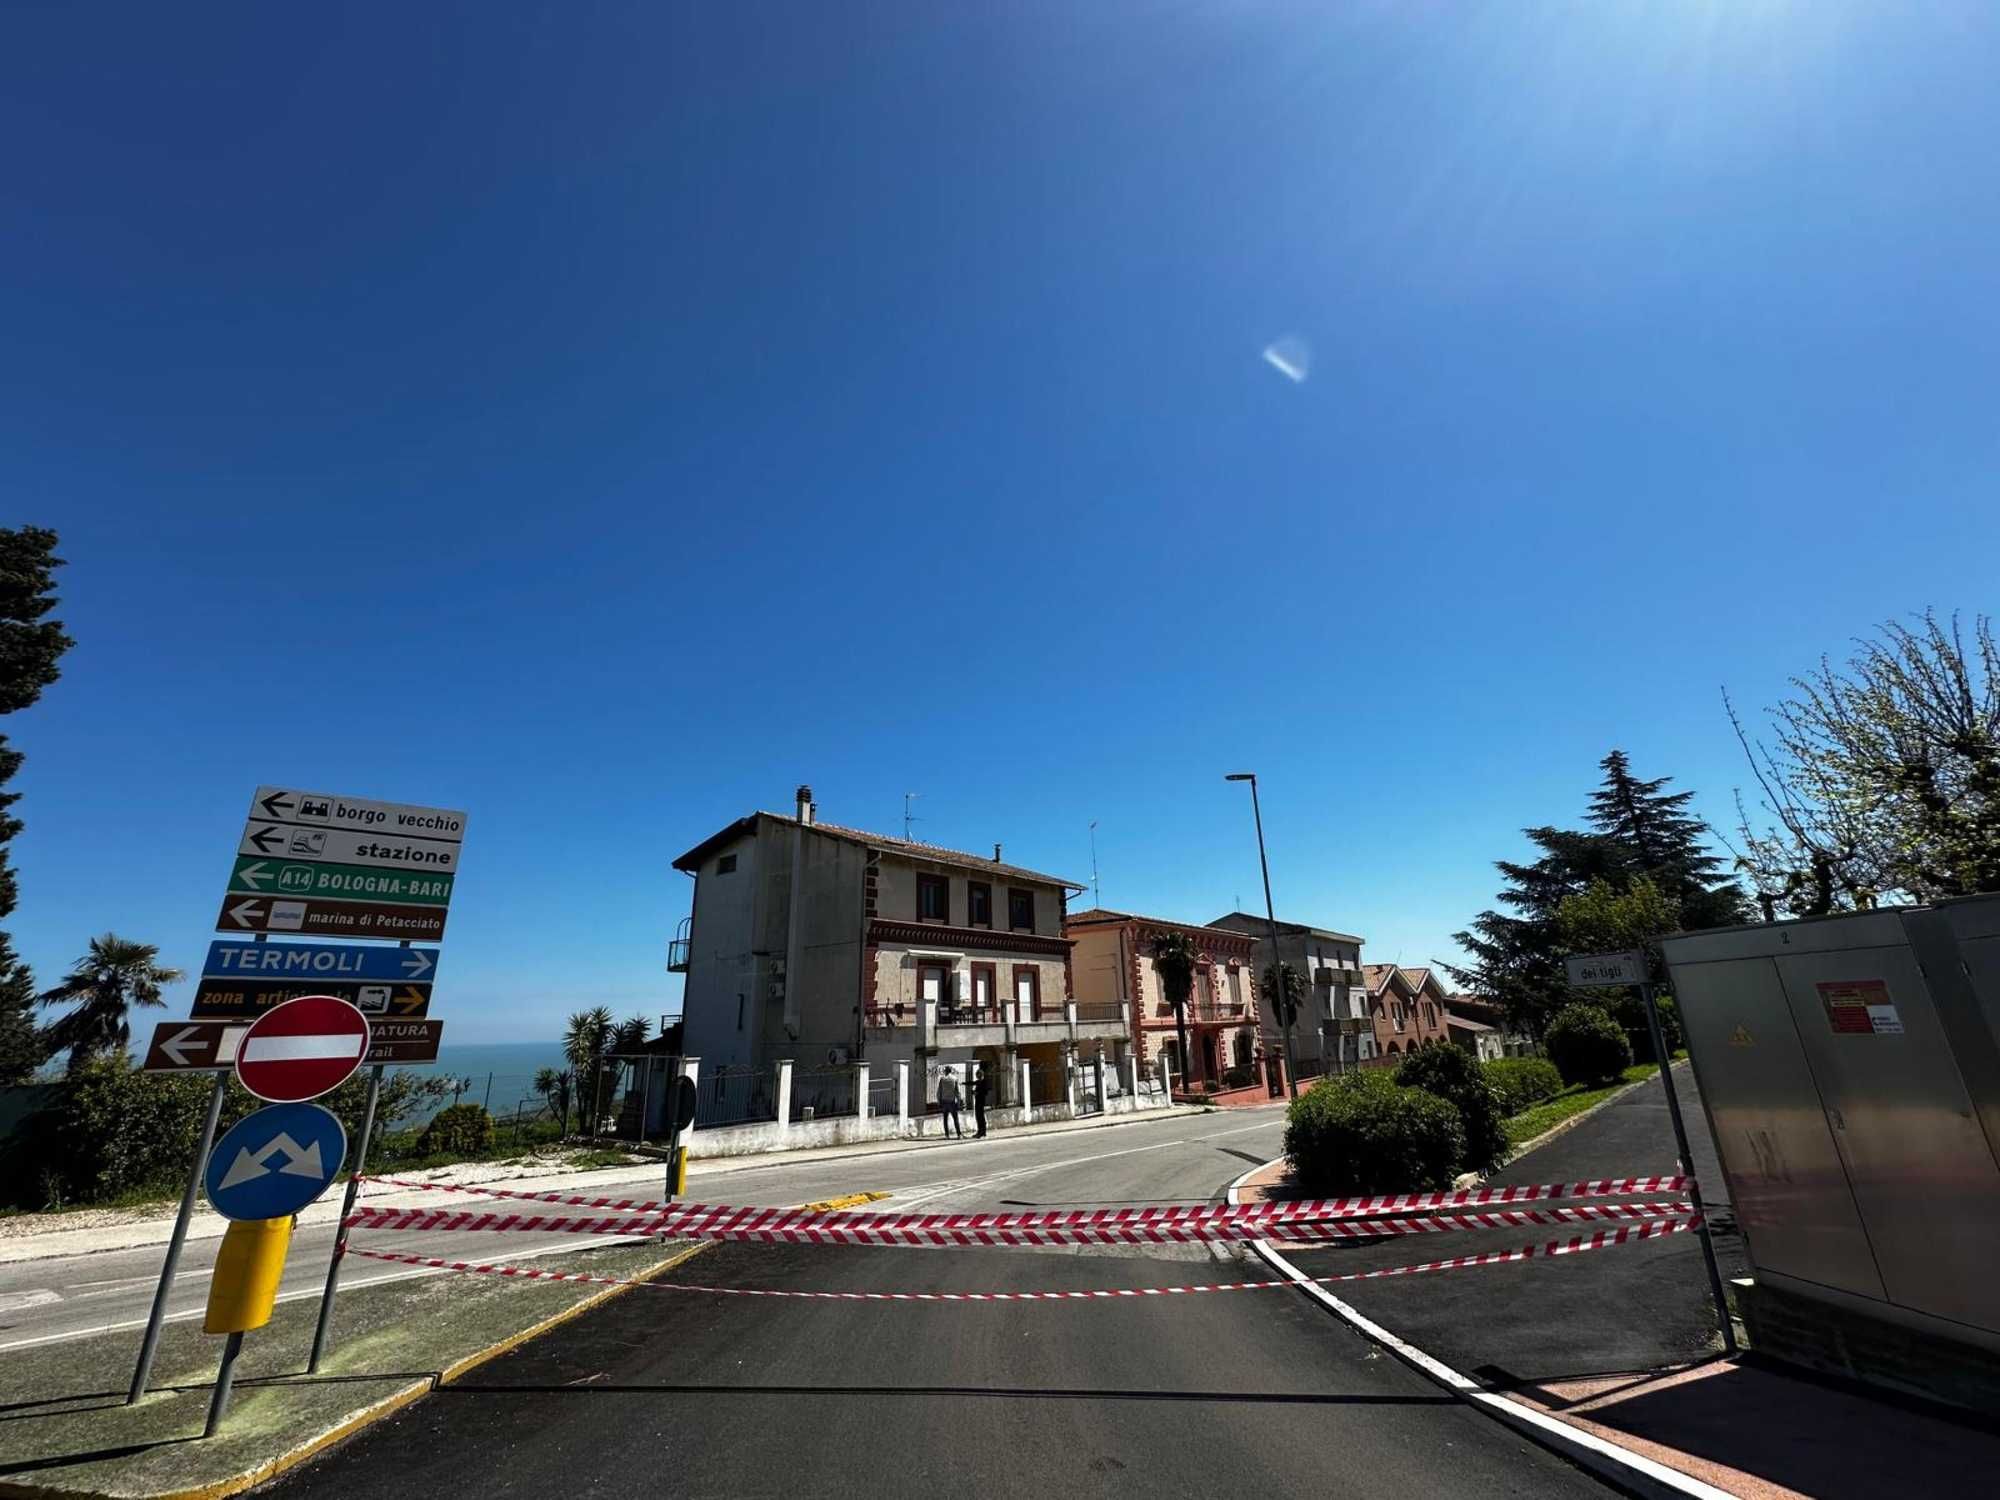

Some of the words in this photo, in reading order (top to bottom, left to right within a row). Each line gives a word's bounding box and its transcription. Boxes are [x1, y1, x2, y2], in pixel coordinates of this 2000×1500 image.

[336, 804, 386, 824] borgo
[398, 812, 460, 832] vecchio
[356, 842, 451, 864] stazione
[281, 871, 311, 886] A14
[317, 873, 450, 897] BOLOGNA-BARI
[308, 913, 354, 926] marina
[360, 913, 371, 926] di
[377, 914, 441, 929] Petacciato
[219, 949, 364, 971] TERMOLI
[202, 991, 245, 1005] zona
